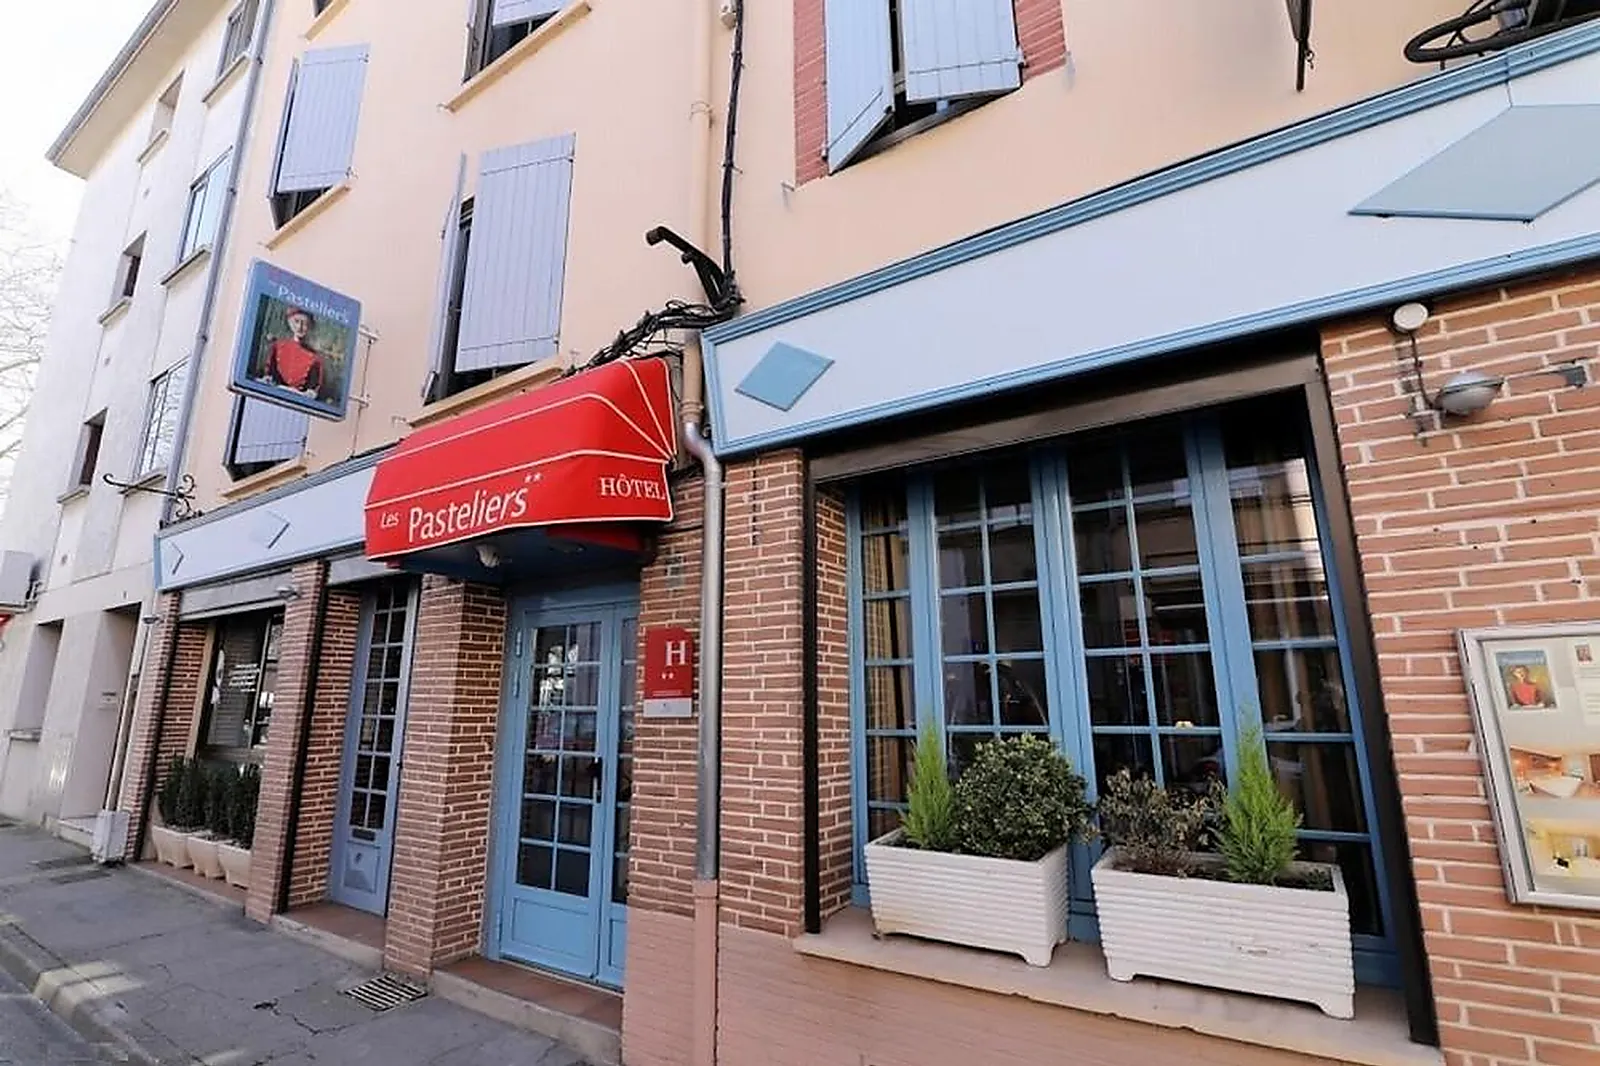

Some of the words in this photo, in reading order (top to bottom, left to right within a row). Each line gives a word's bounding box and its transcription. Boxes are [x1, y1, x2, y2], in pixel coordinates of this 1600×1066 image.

[600, 473, 666, 500] HÔTEL
[380, 511, 400, 529] Les
[409, 487, 528, 543] Pasteliers
[665, 640, 687, 666] H
